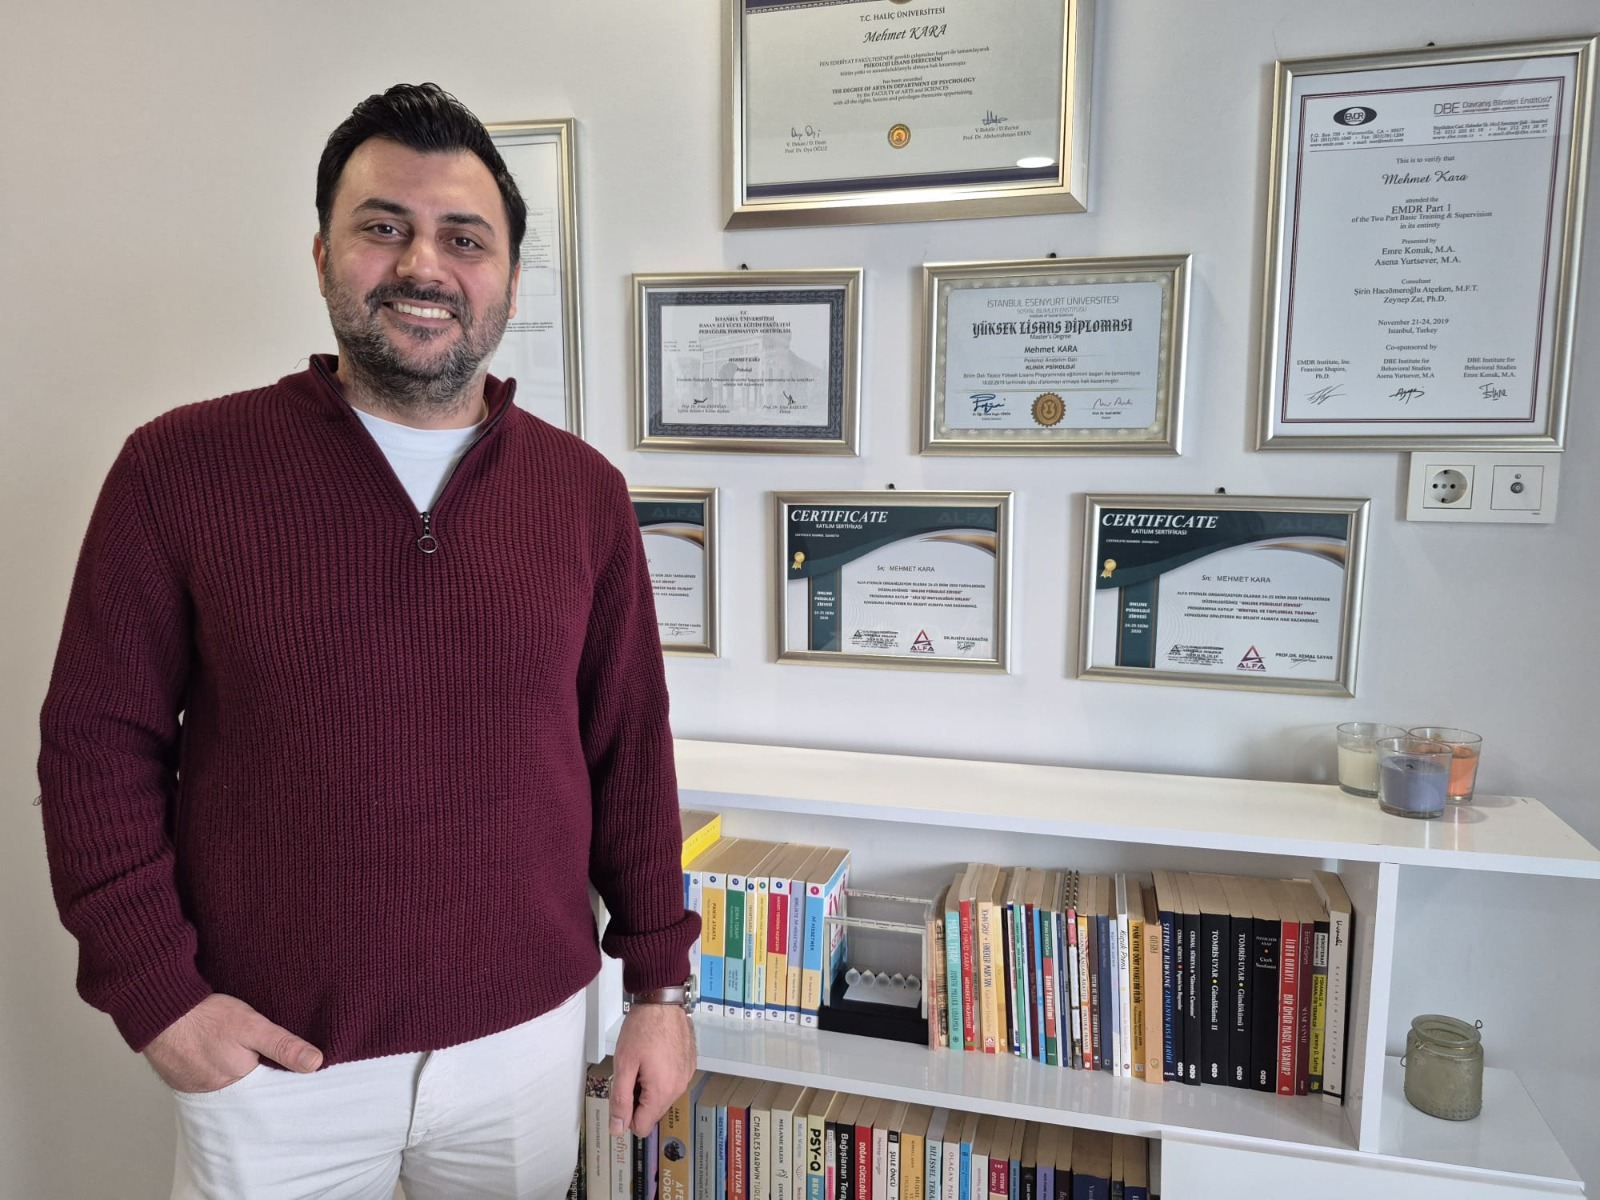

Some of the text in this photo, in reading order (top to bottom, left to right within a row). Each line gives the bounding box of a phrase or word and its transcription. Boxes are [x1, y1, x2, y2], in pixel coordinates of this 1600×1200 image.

[859, 14, 870, 22] T.C.
[896, 6, 946, 19] ÜNİVERSİTESİ
[861, 23, 949, 43] Mehmet KARA
[938, 76, 976, 87] PSYCHOLOGY
[1433, 101, 1460, 116] DBE
[1395, 156, 1409, 164] This
[1424, 155, 1441, 163] verify
[1381, 169, 1468, 185] Mehmet Kara
[1351, 215, 1358, 223] of
[1371, 213, 1384, 222] Two
[1385, 212, 1398, 221] Part
[1399, 211, 1416, 221] Basic
[1419, 210, 1445, 221] Training
[1446, 211, 1452, 219] &
[1454, 210, 1493, 219] Supervision
[1391, 204, 1423, 216] EMDR
[1425, 203, 1443, 212] Part
[1381, 245, 1456, 255] Emre Konuk, M.A.
[1374, 255, 1461, 266] Asena Yurtsever, M.A.
[986, 298, 1021, 309] İSTANBUL
[1024, 297, 1064, 308] ESENYURT
[1383, 294, 1447, 304] Zeynep Zat, Ph.D.
[972, 318, 1133, 337] YÜKSEK LİSANS DİPLOMASI
[1377, 318, 1409, 326] November
[1432, 317, 1449, 325] 2019
[1052, 332, 1072, 340] Degree
[1416, 326, 1438, 334] Turkey
[1024, 344, 1078, 354] Mehmet KARA
[1429, 343, 1437, 351] by
[790, 509, 888, 523] CERTIFICATE
[1101, 512, 1219, 528] CERTIFICATE
[1154, 528, 1188, 536] SERTİFİKASI
[1216, 574, 1248, 582] MEHMET
[1236, 662, 1267, 671] ALFA
[1162, 922, 1170, 952] STEPHEN
[1237, 933, 1245, 961] TOMRİS
[1302, 945, 1310, 965] Fromm
[962, 950, 972, 972] KARAY
[1118, 948, 1129, 972] Prens
[1237, 961, 1245, 982] UYAR
[1043, 974, 1056, 1021] Sınıf Yönetimi
[1210, 985, 1218, 1022] Gündökümü
[1283, 993, 1294, 1005] BİR
[1236, 988, 1245, 1026] Gündökümü
[1282, 1003, 1294, 1023] ÖMÜR
[1312, 1032, 1322, 1050] Jeremy
[1311, 1056, 1320, 1073] Safran
[752, 1115, 761, 1150] CHARLES
[809, 1128, 821, 1172] PSY-Q
[839, 1133, 848, 1178] Bağışlanan
[753, 1151, 761, 1180] DARWIN
[858, 1141, 866, 1200] DOĞAN CÜCELOĞLU
[889, 1151, 897, 1188] ŞULE ÖNCÜ
[734, 1170, 742, 1194] TUTAR
[811, 1177, 819, 1196] BEN
